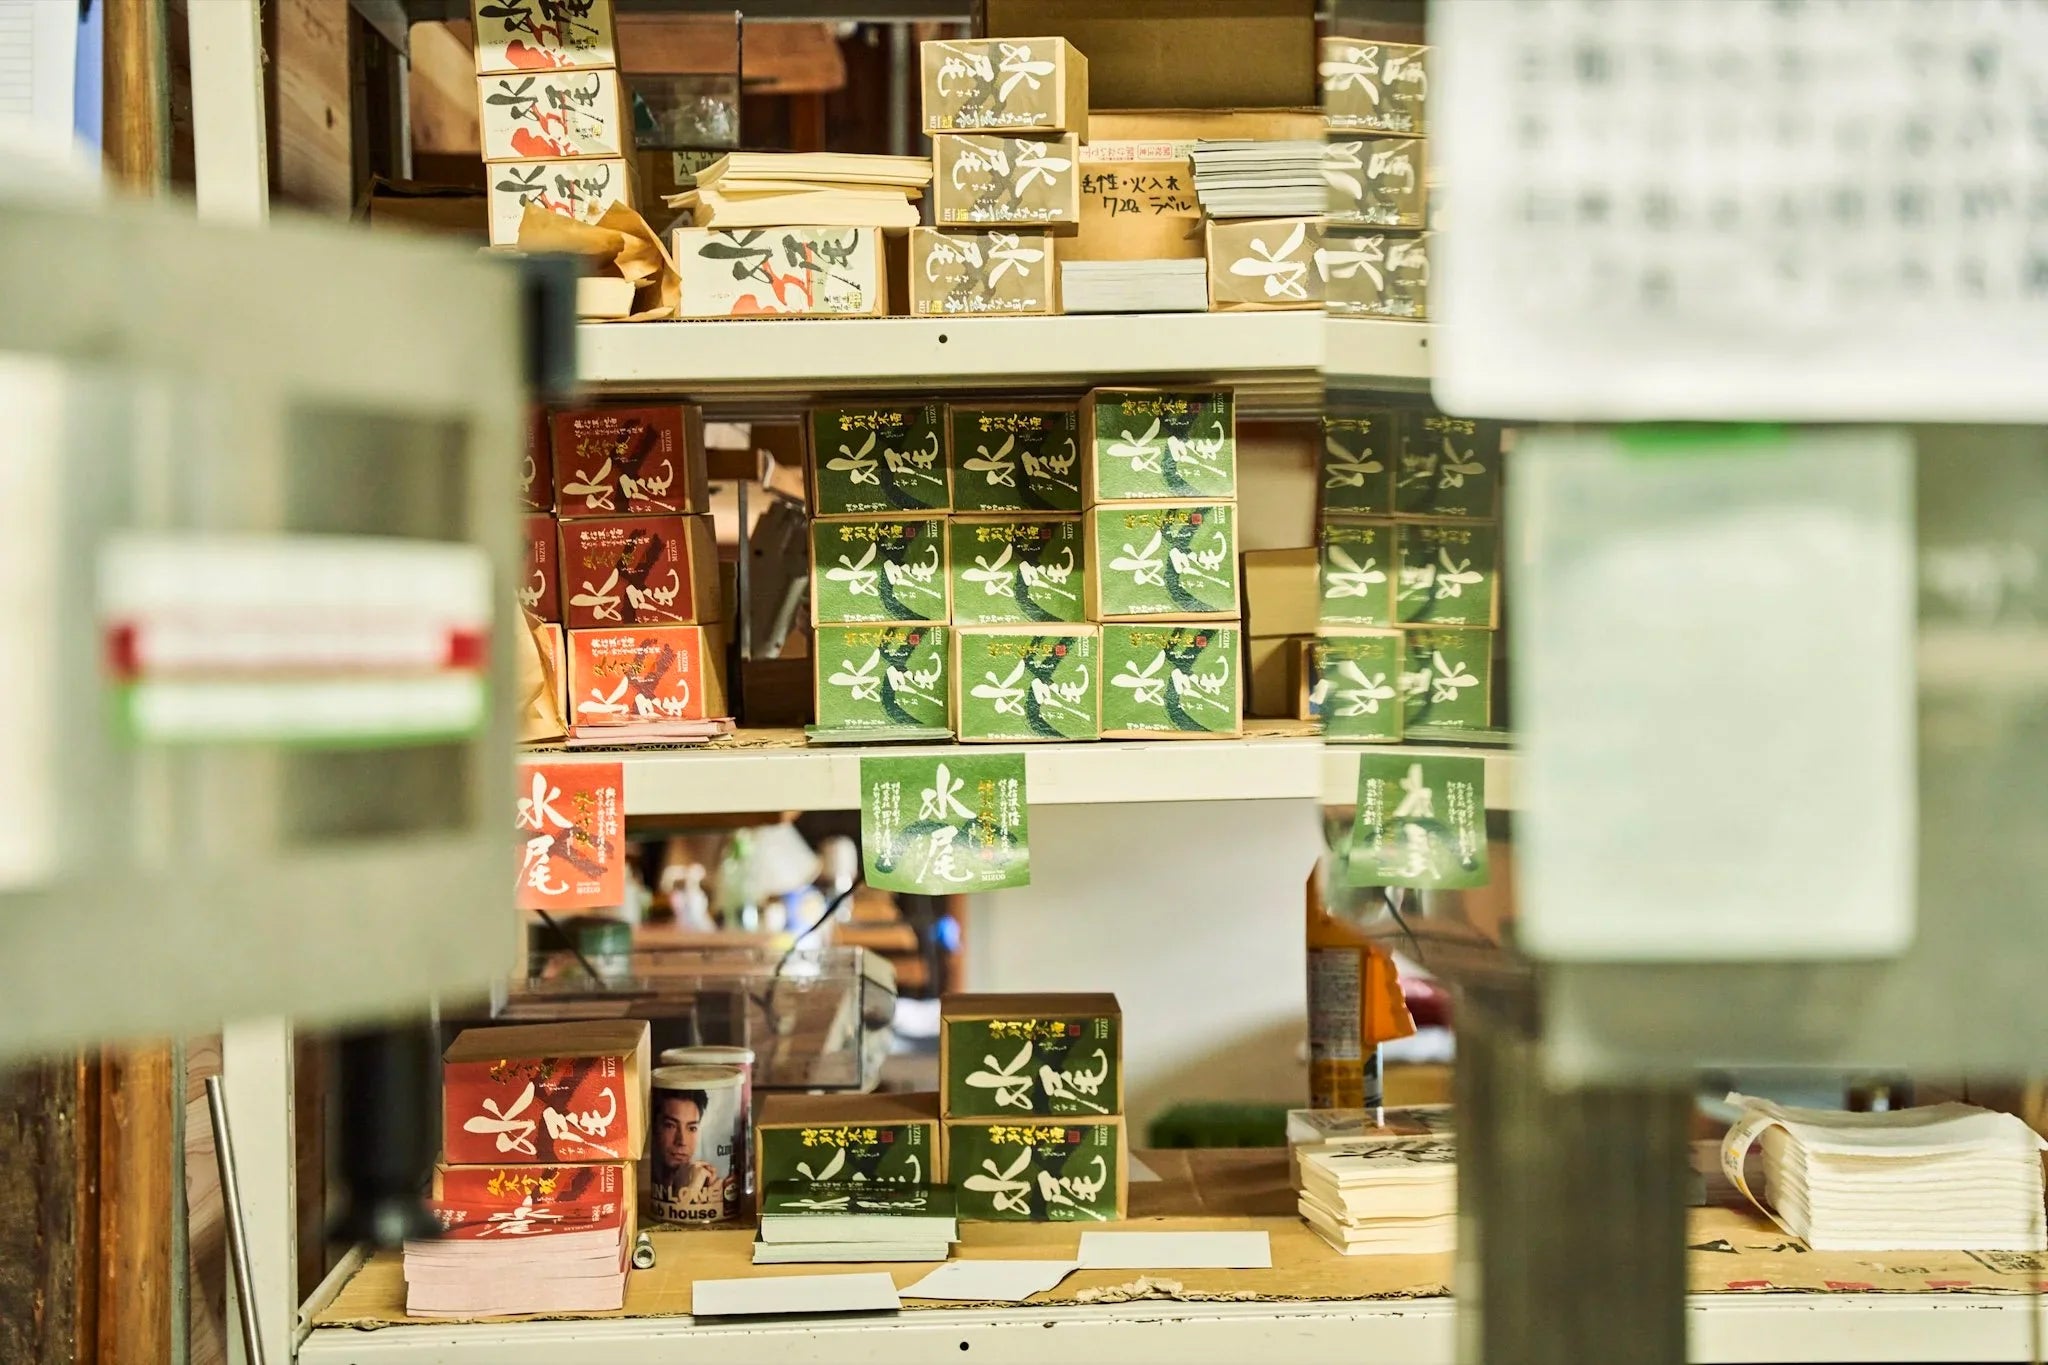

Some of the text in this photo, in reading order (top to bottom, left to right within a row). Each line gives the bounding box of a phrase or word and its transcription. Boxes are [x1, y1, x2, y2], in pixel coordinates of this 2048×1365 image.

[486, 73, 604, 123] 水尾
[936, 42, 1055, 102] 水尾
[952, 135, 1072, 198] 水尾
[1149, 196, 1192, 215] ラベル
[699, 229, 861, 290] 水尾
[925, 229, 1044, 289] 水尾
[1229, 222, 1328, 299] 水
[826, 431, 942, 485] 水尾
[963, 434, 1077, 492] 水尾
[1107, 417, 1227, 477] 水尾
[562, 457, 676, 511] 水尾
[826, 542, 941, 599] 水尾
[962, 543, 1076, 600] 水尾
[1109, 530, 1230, 588] 水尾
[569, 568, 683, 621] 水尾
[828, 648, 943, 707] 水尾
[970, 659, 1090, 720] 水尾
[1111, 649, 1229, 712] 水尾
[516, 772, 573, 895] 水尾
[915, 763, 977, 883] 水尾
[988, 1019, 1065, 1040] 特別純米酒
[965, 1041, 1109, 1114] 水尾
[463, 1081, 619, 1158] 水尾
[801, 1126, 878, 1147] 特別純米酒
[988, 1125, 1065, 1146] 特別純米酒
[606, 1166, 614, 1192] MIZUO
[963, 1146, 1107, 1222] 水尾
[669, 1206, 717, 1220] house
